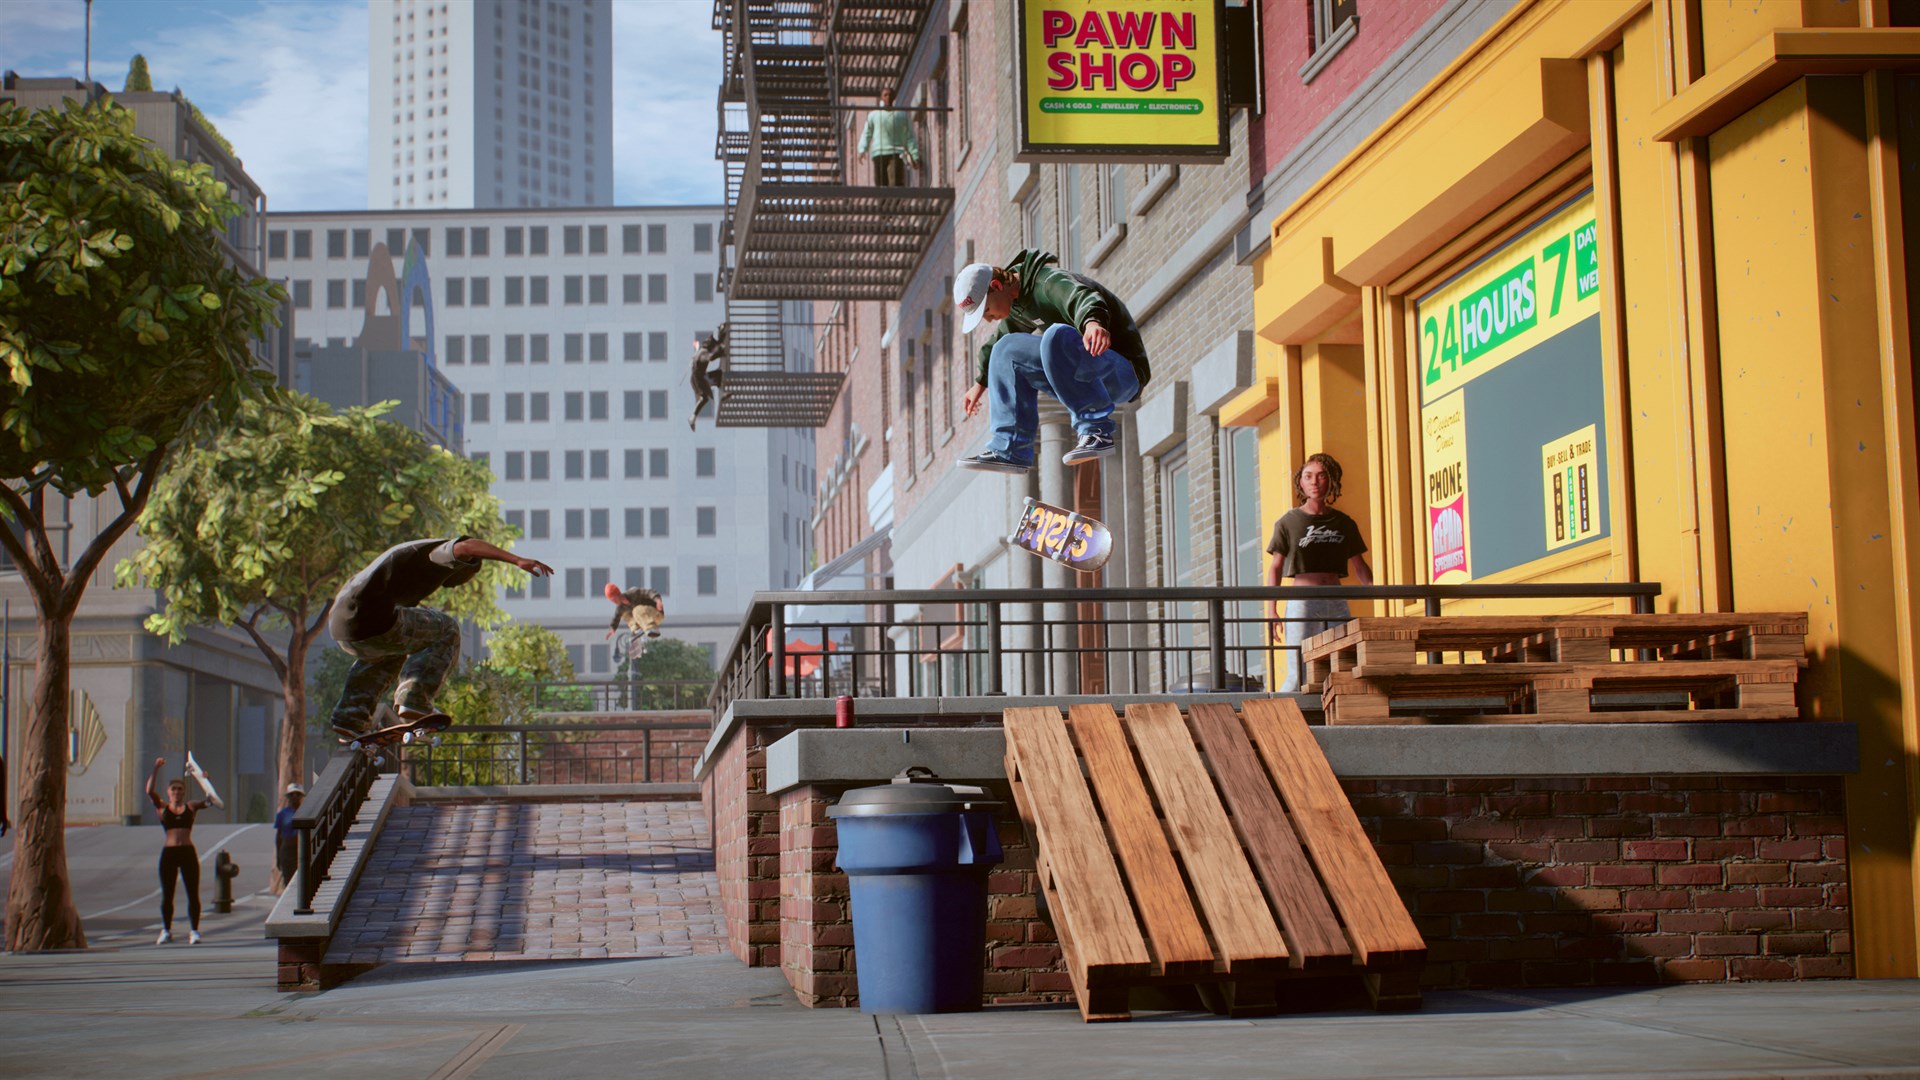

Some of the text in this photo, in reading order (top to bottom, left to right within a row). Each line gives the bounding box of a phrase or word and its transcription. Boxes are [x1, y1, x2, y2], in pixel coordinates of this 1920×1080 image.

[1042, 10, 1197, 49] PAWN
[1047, 52, 1196, 91] SHOP
[1590, 250, 1597, 265] A
[1424, 232, 1571, 386] 24 HOURS 7
[1576, 440, 1591, 457] TRADE
[1429, 461, 1463, 505] PHONE
[1580, 467, 1588, 531] SILVER
[1555, 475, 1563, 538] GOLD
[1433, 507, 1463, 556] REPAIR
